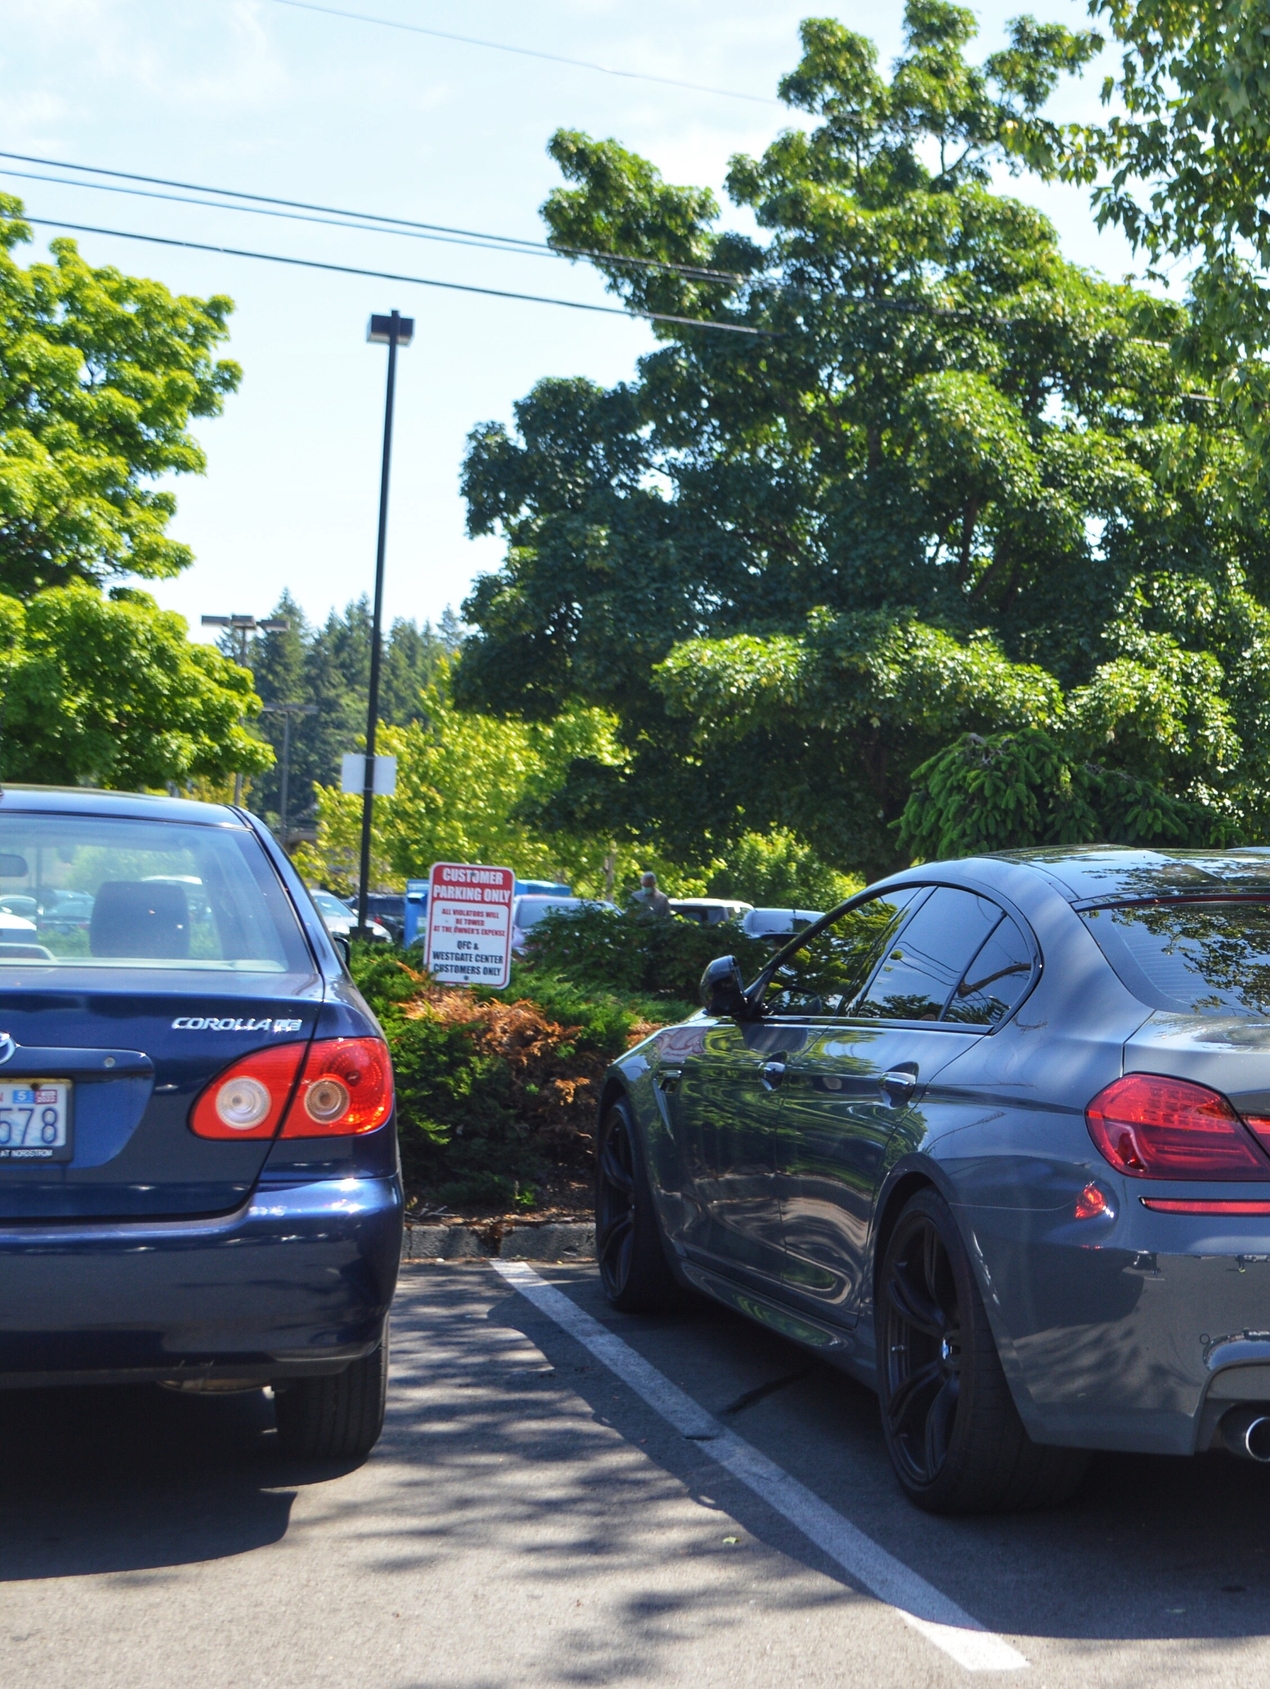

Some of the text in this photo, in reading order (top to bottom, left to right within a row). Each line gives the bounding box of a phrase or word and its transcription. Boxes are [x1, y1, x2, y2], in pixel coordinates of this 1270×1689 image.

[443, 868, 503, 886] CUSTOMER
[433, 884, 512, 903] PARKING ONLY
[453, 908, 484, 918] VIOLATORS
[486, 910, 500, 919] WILL
[464, 918, 485, 926] TOWED
[454, 926, 480, 935] OWNER'S
[481, 929, 506, 937] EXPENSE
[457, 940, 472, 950] QFC
[432, 951, 504, 964] WESTGATE CENTER
[433, 963, 502, 977] CUSTOMERS ONLY
[171, 1017, 272, 1031] COROLLA
